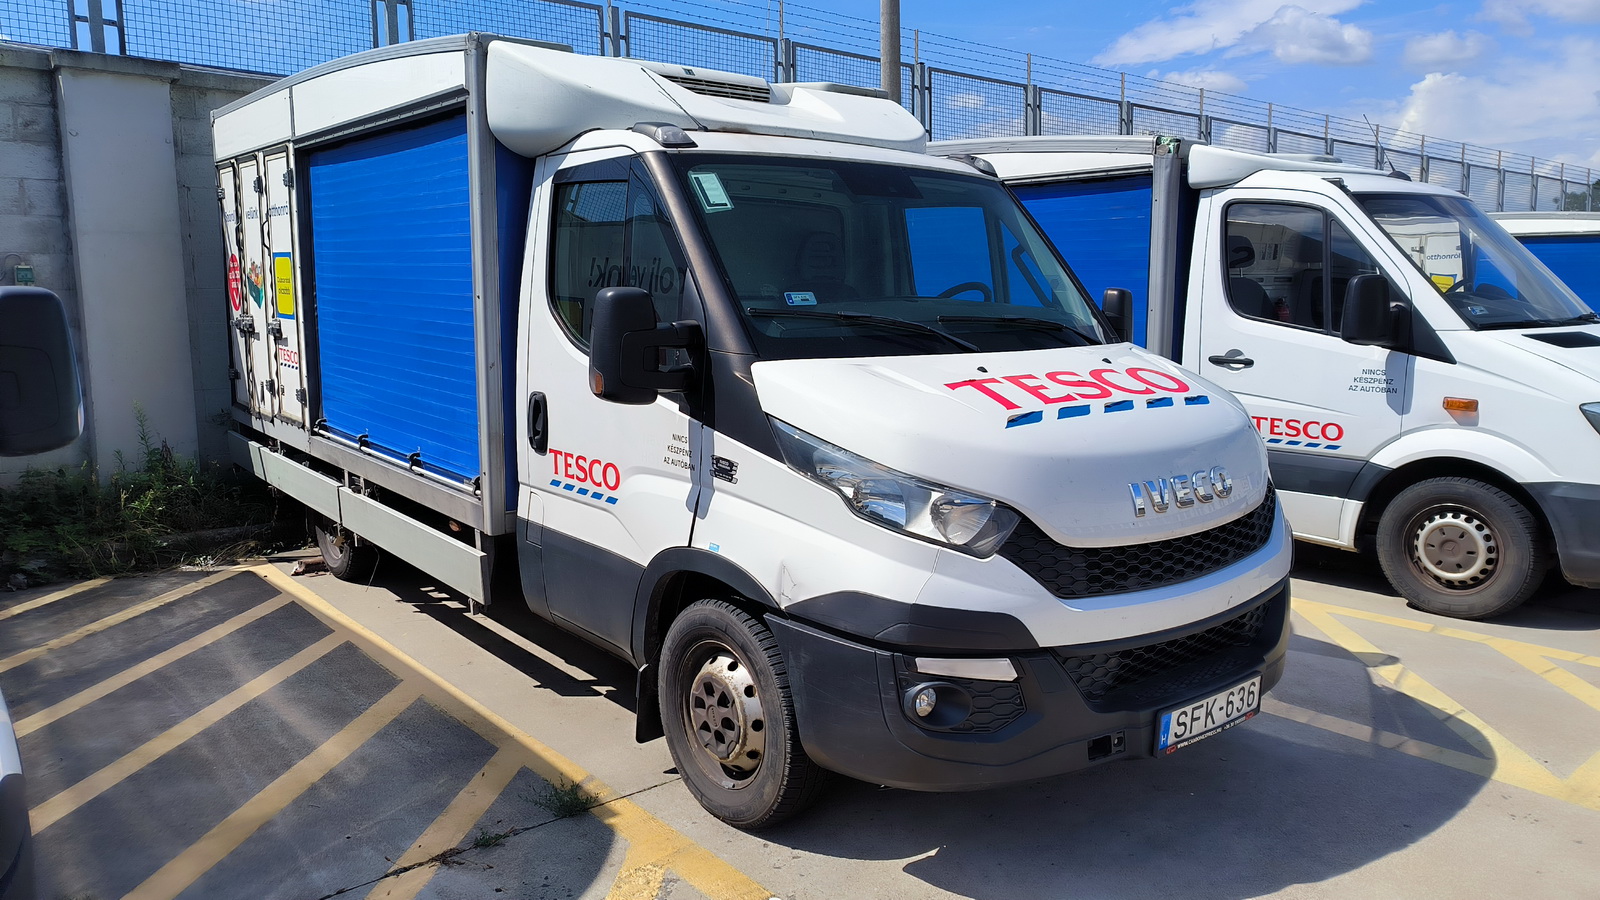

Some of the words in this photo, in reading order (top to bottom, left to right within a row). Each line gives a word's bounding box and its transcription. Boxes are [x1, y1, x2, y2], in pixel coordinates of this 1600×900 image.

[279, 347, 298, 365] TESCO
[943, 367, 1190, 410] TESCO
[1360, 385, 1398, 394] AUTÓBAN
[1251, 416, 1344, 441] TESCO
[672, 433, 688, 444] NINCS
[667, 443, 693, 458] KÉSZPÉNZ
[549, 448, 620, 491] TESCO
[663, 456, 670, 465] AZ
[671, 458, 696, 472] AUTÓBAN
[1127, 465, 1233, 518] IVECO
[1174, 681, 1257, 739] SFK-636
[1161, 734, 1167, 745] H
